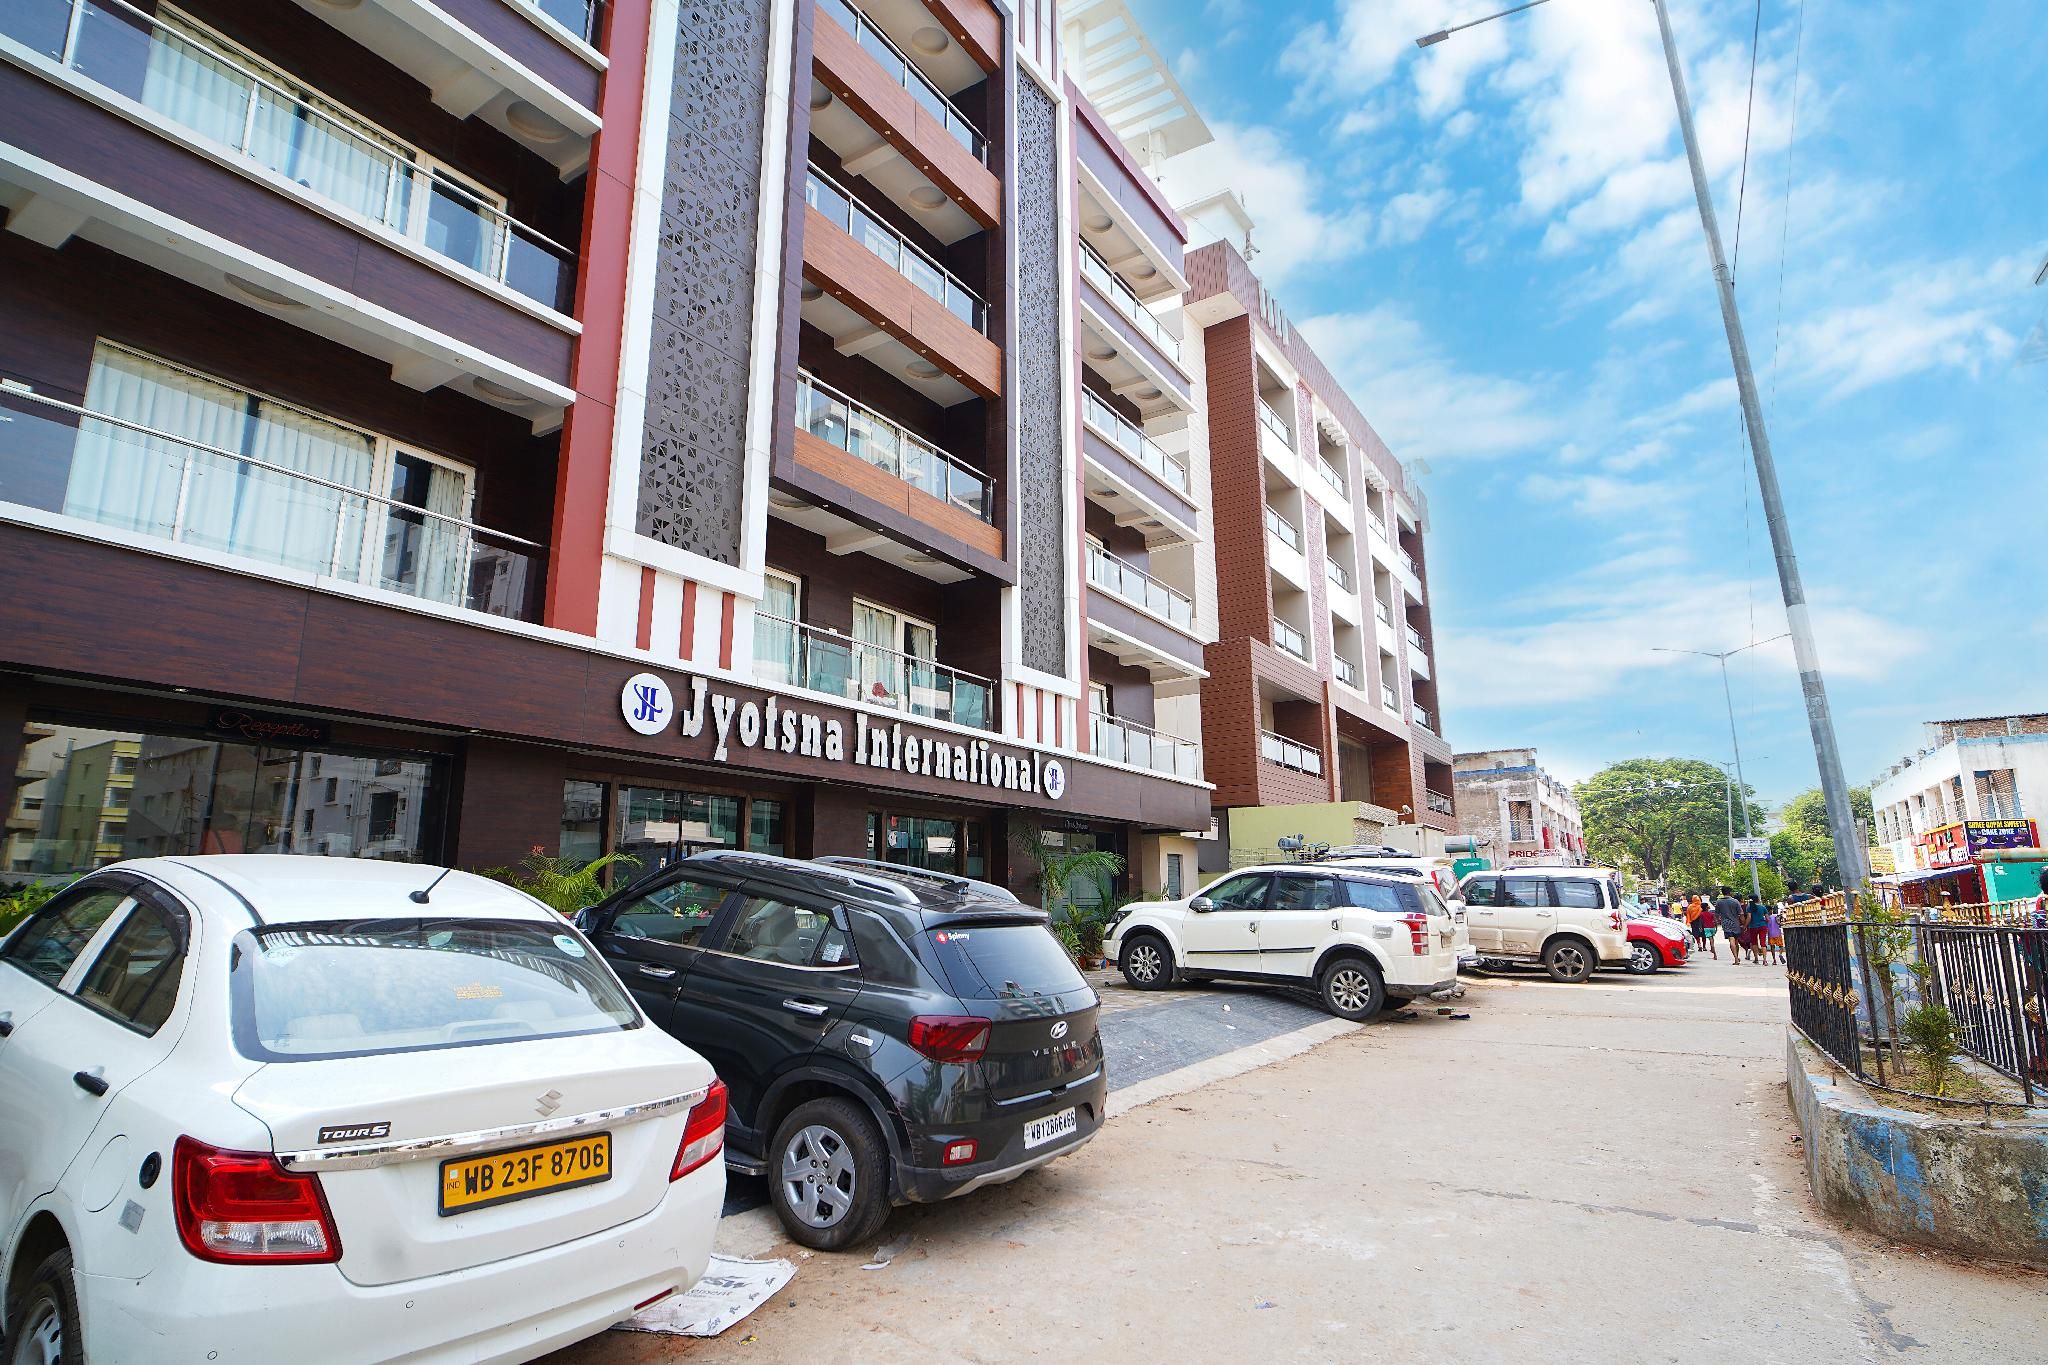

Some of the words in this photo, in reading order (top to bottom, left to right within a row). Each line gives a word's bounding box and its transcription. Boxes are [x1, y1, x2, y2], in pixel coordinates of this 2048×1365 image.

[682, 676, 844, 761] Jyotsna
[855, 712, 1041, 793] International
[2003, 820, 2027, 828] SWEETS
[1508, 850, 1539, 858] PRIDE
[1032, 1040, 1077, 1057] VENUE
[464, 1164, 494, 1195] WB
[501, 1153, 544, 1188] 23F
[551, 1143, 604, 1177] 8706
[446, 1180, 460, 1190] IND
